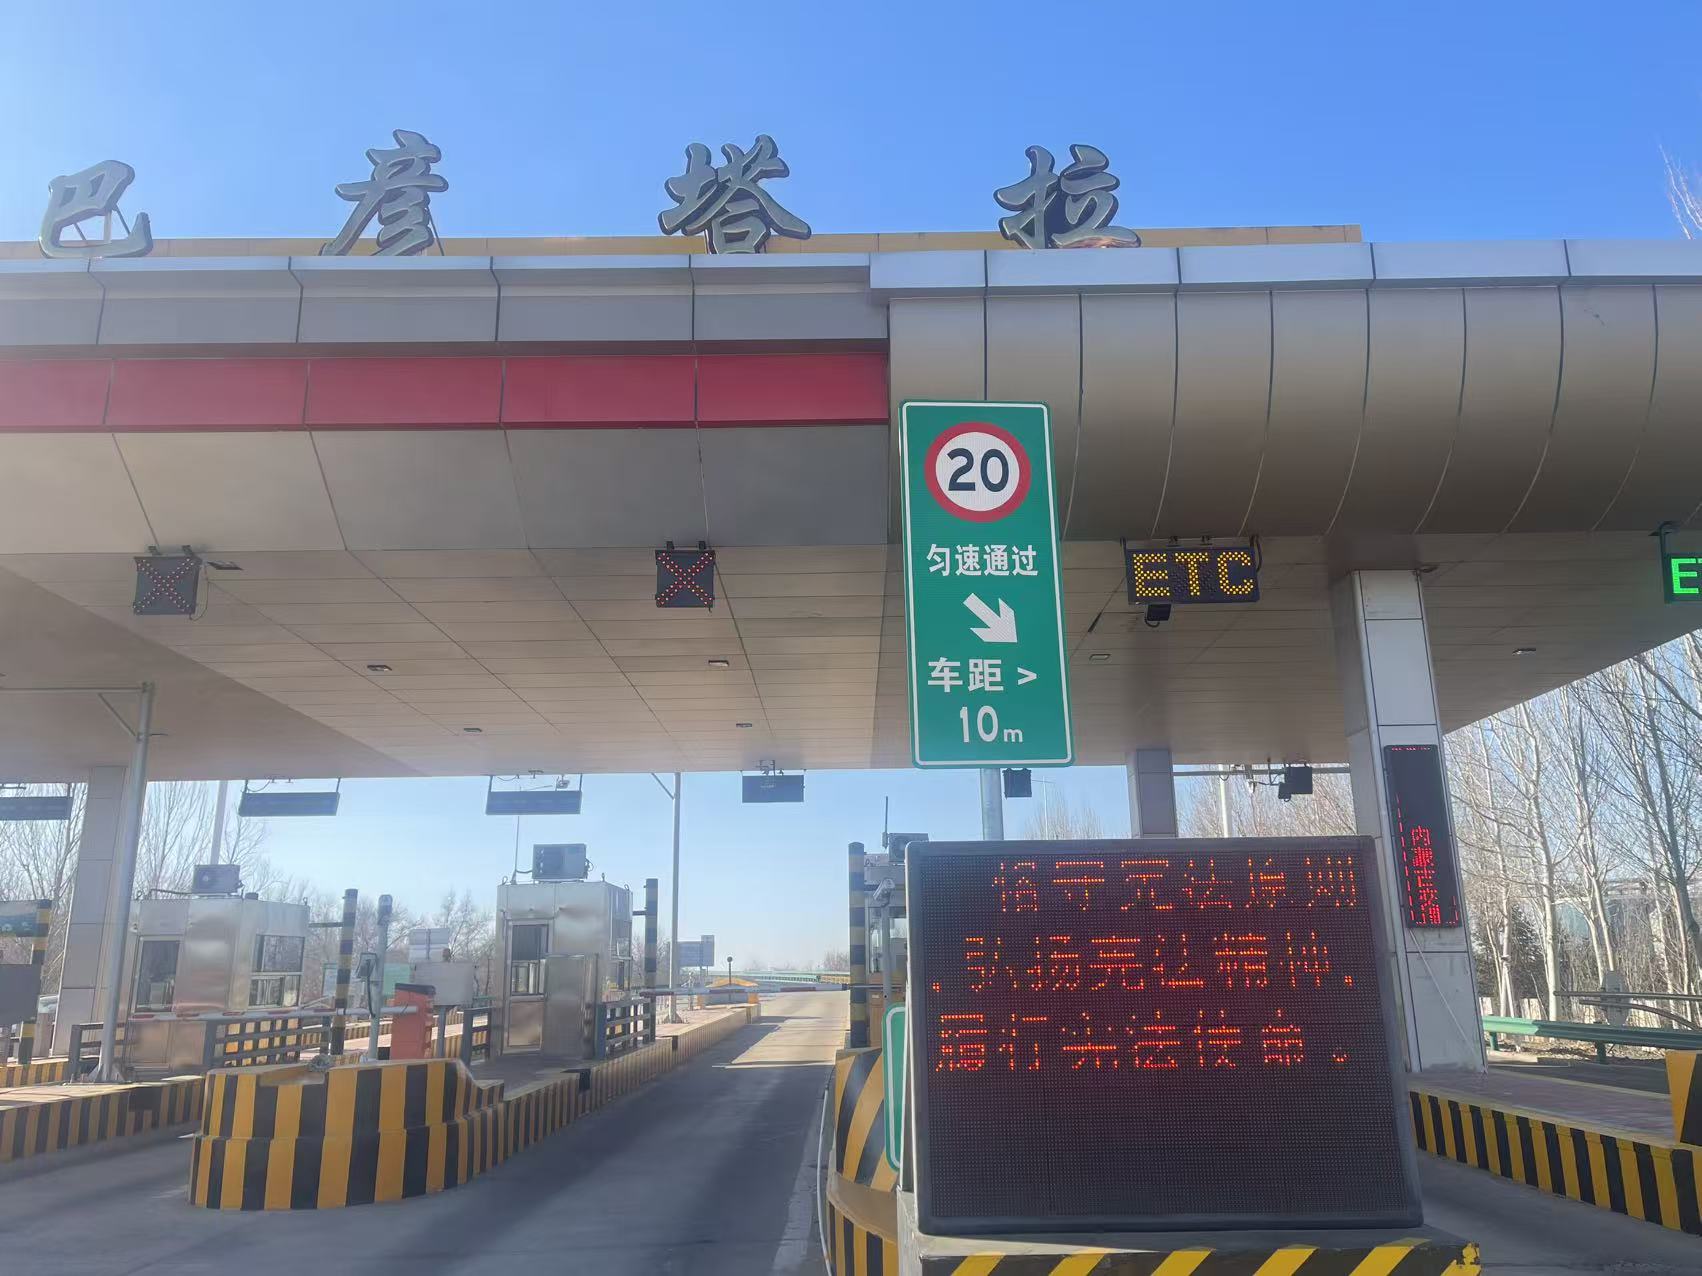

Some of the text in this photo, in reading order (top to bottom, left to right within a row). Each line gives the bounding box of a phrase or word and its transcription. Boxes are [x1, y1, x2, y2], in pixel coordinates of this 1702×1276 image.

[39, 129, 1142, 257] 巴彦塔拉
[946, 447, 1010, 493] 20
[926, 543, 1039, 578] 匀速通过
[1132, 550, 1255, 597] ETC
[1671, 558, 1702, 594] E
[959, 704, 1024, 744] 10m
